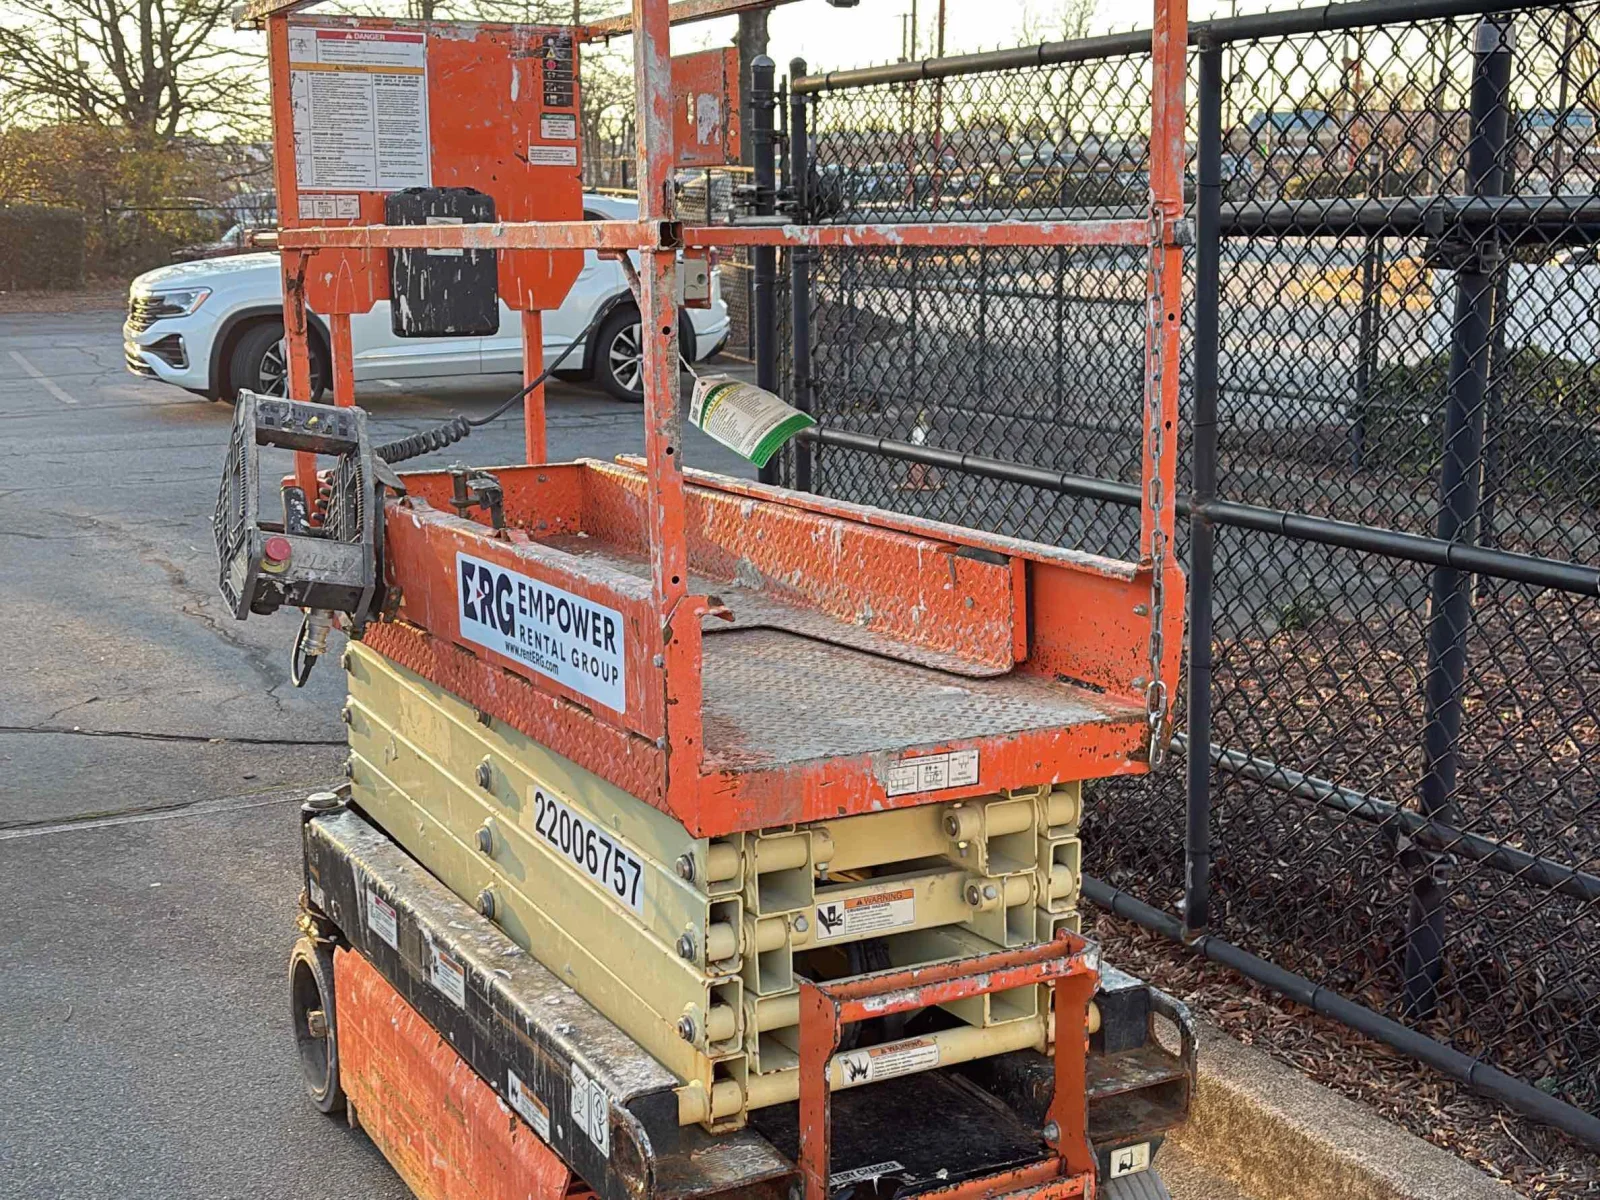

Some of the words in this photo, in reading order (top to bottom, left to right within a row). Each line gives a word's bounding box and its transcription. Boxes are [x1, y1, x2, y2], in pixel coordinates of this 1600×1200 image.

[354, 33, 386, 41] DANGER
[517, 581, 617, 655] EMPOWER
[504, 640, 560, 676] www.rentERG.com
[519, 624, 566, 663] RENTAL
[571, 647, 619, 686] GROUP
[535, 791, 641, 906] 22006757
[864, 892, 903, 905] WARNING
[887, 1040, 923, 1052] WARNING
[830, 1171, 856, 1184] TTERY
[856, 1163, 898, 1174] CHARGER
